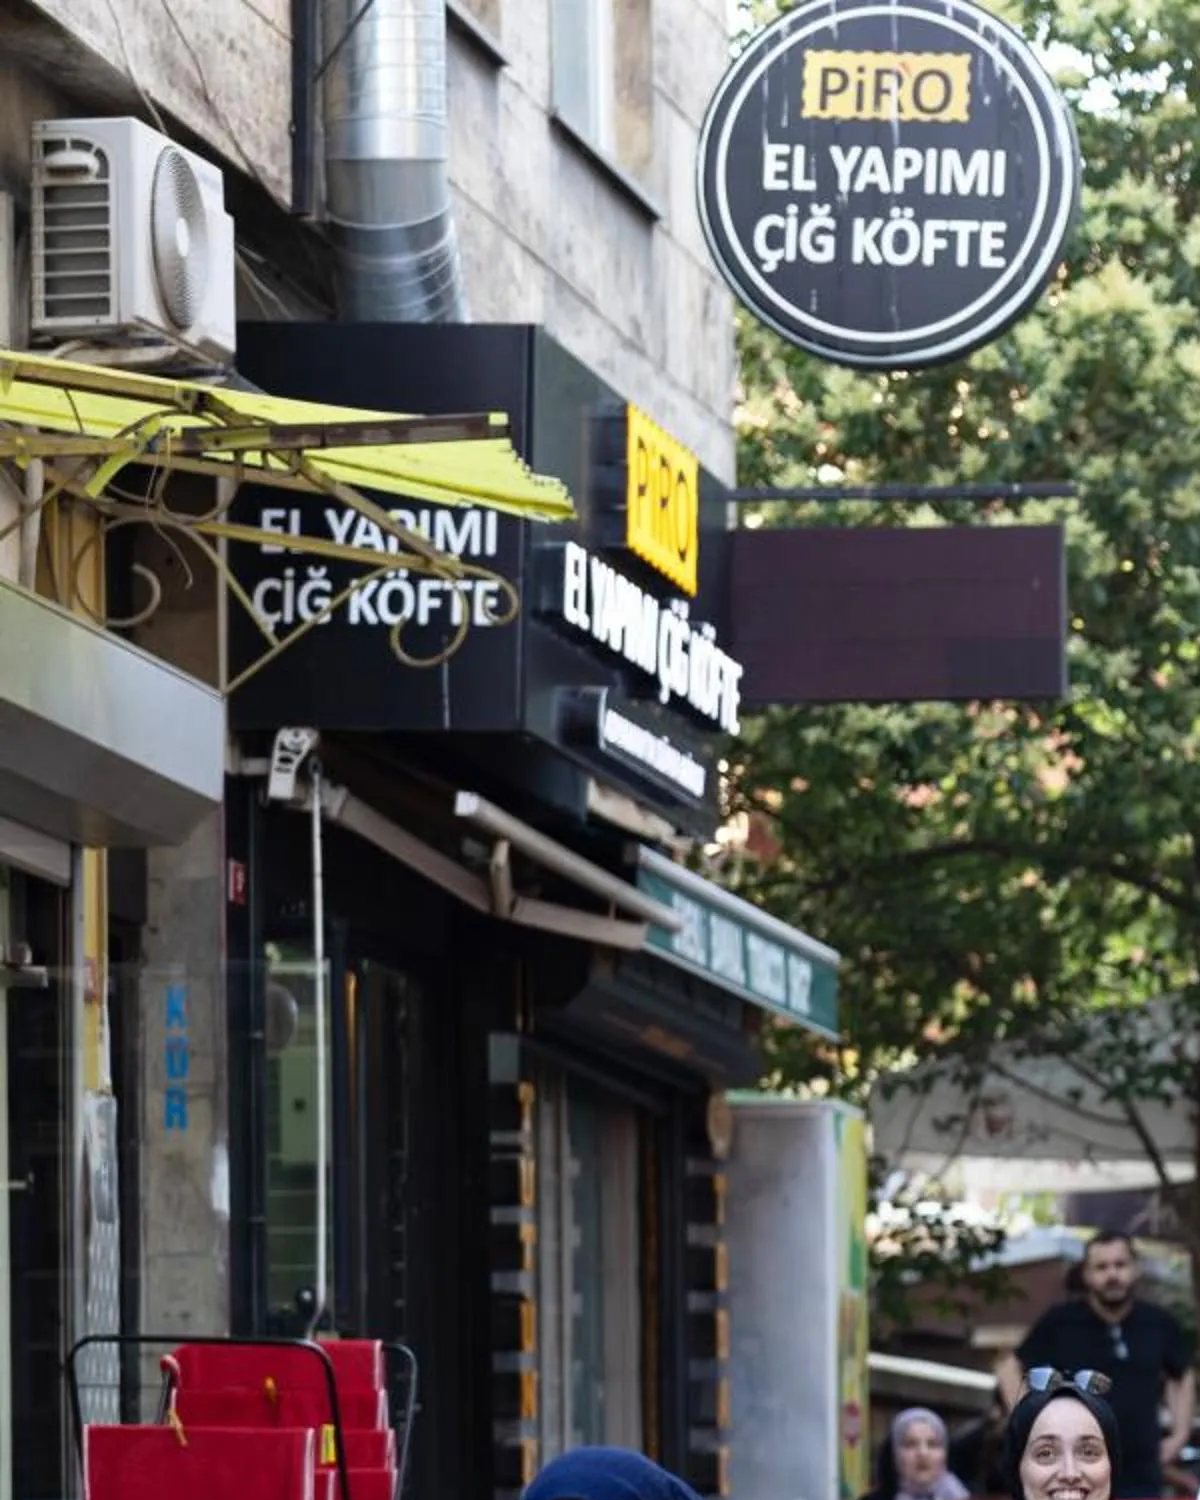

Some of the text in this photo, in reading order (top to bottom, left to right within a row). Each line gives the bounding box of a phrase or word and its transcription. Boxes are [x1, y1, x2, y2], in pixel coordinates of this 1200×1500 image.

[762, 143, 1007, 197] EL YAPIMI
[753, 203, 1008, 273] ÇİĞ KÖFTE
[252, 566, 501, 633] ÇİĞ KÖFTE
